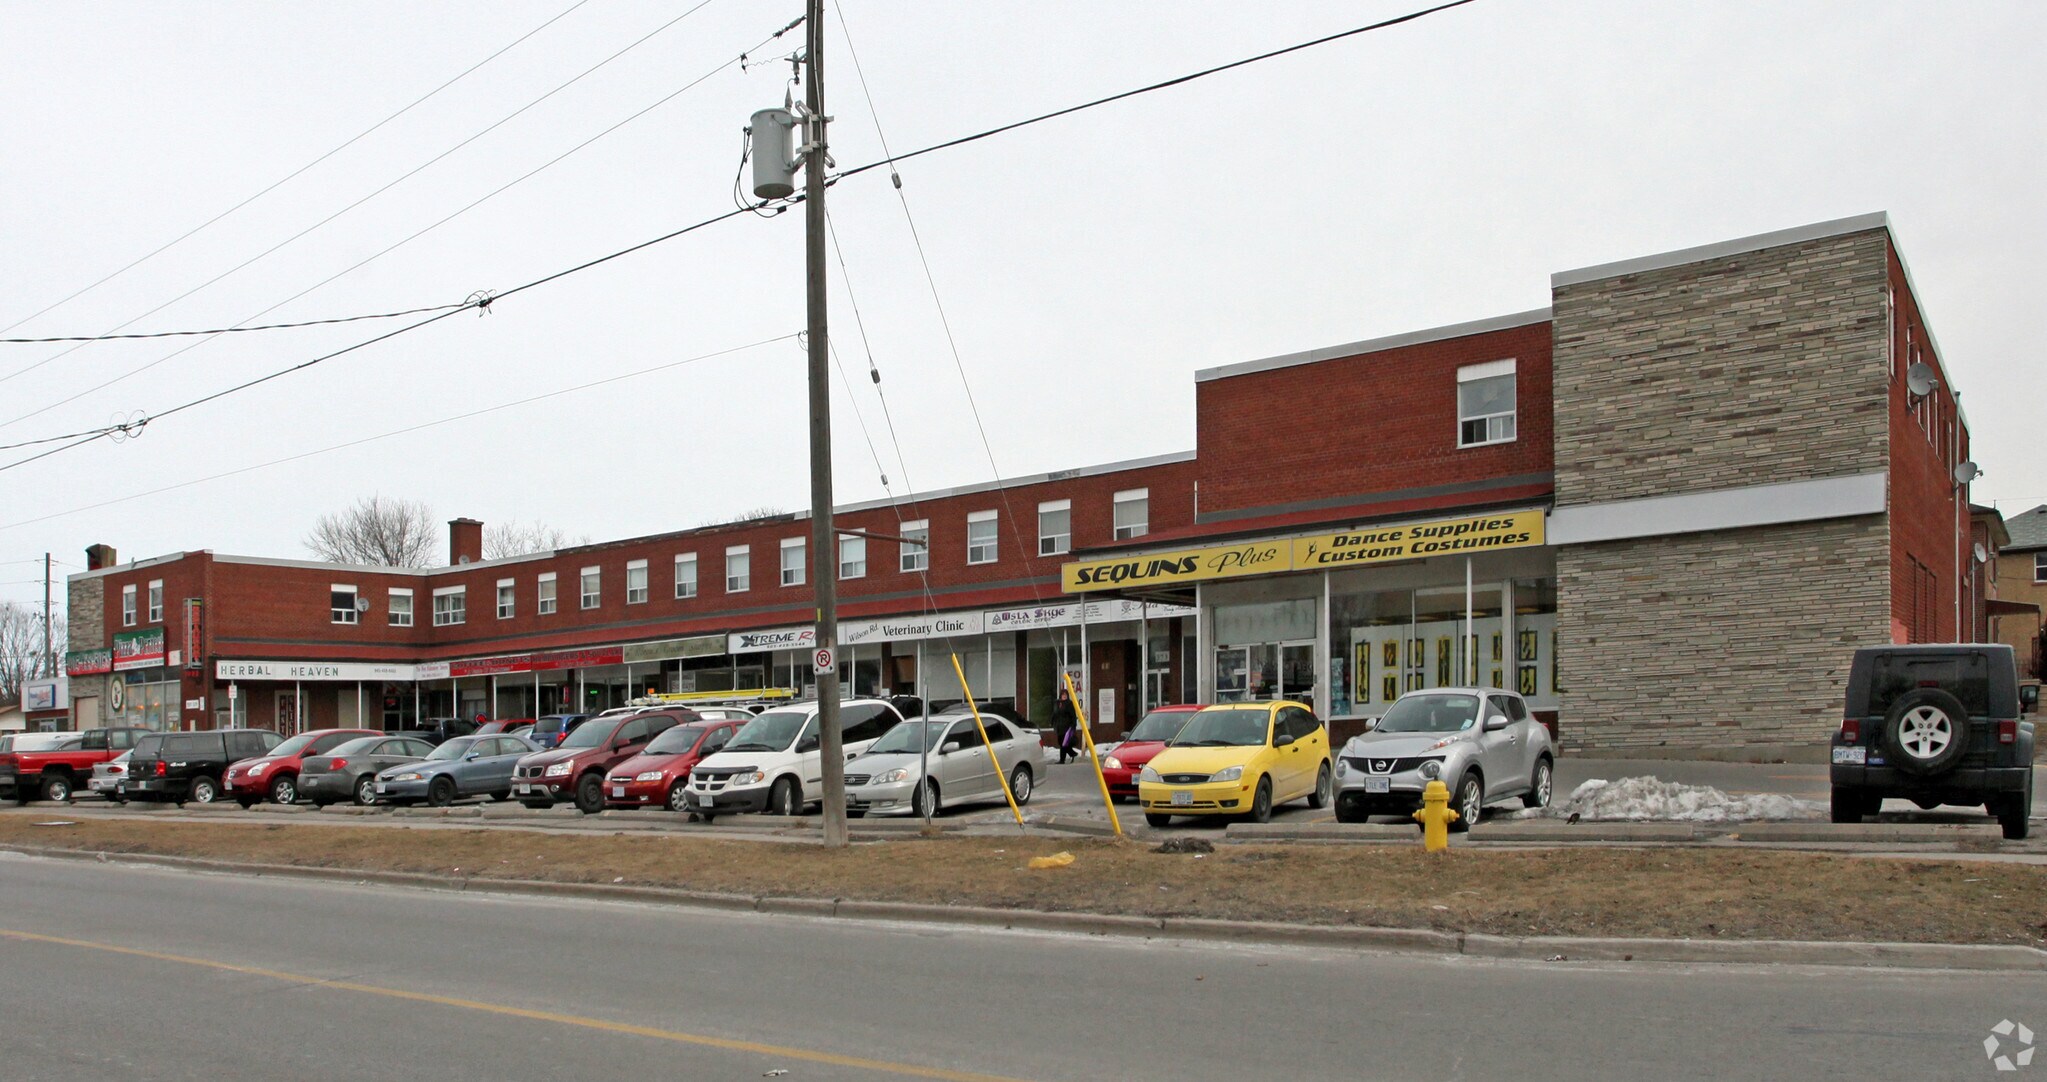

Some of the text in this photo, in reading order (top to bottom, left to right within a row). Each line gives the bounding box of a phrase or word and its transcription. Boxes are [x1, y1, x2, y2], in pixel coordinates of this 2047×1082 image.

[1332, 518, 1515, 548] Dance Supplies
[1318, 531, 1530, 563] Custom Costumes
[1074, 547, 1277, 584] SEQUINS Plus
[848, 628, 869, 643] Wilson
[882, 620, 965, 637] Veterinary Clinic
[740, 631, 795, 648] XTREME
[220, 665, 339, 677] HERBAL HEAVEN
